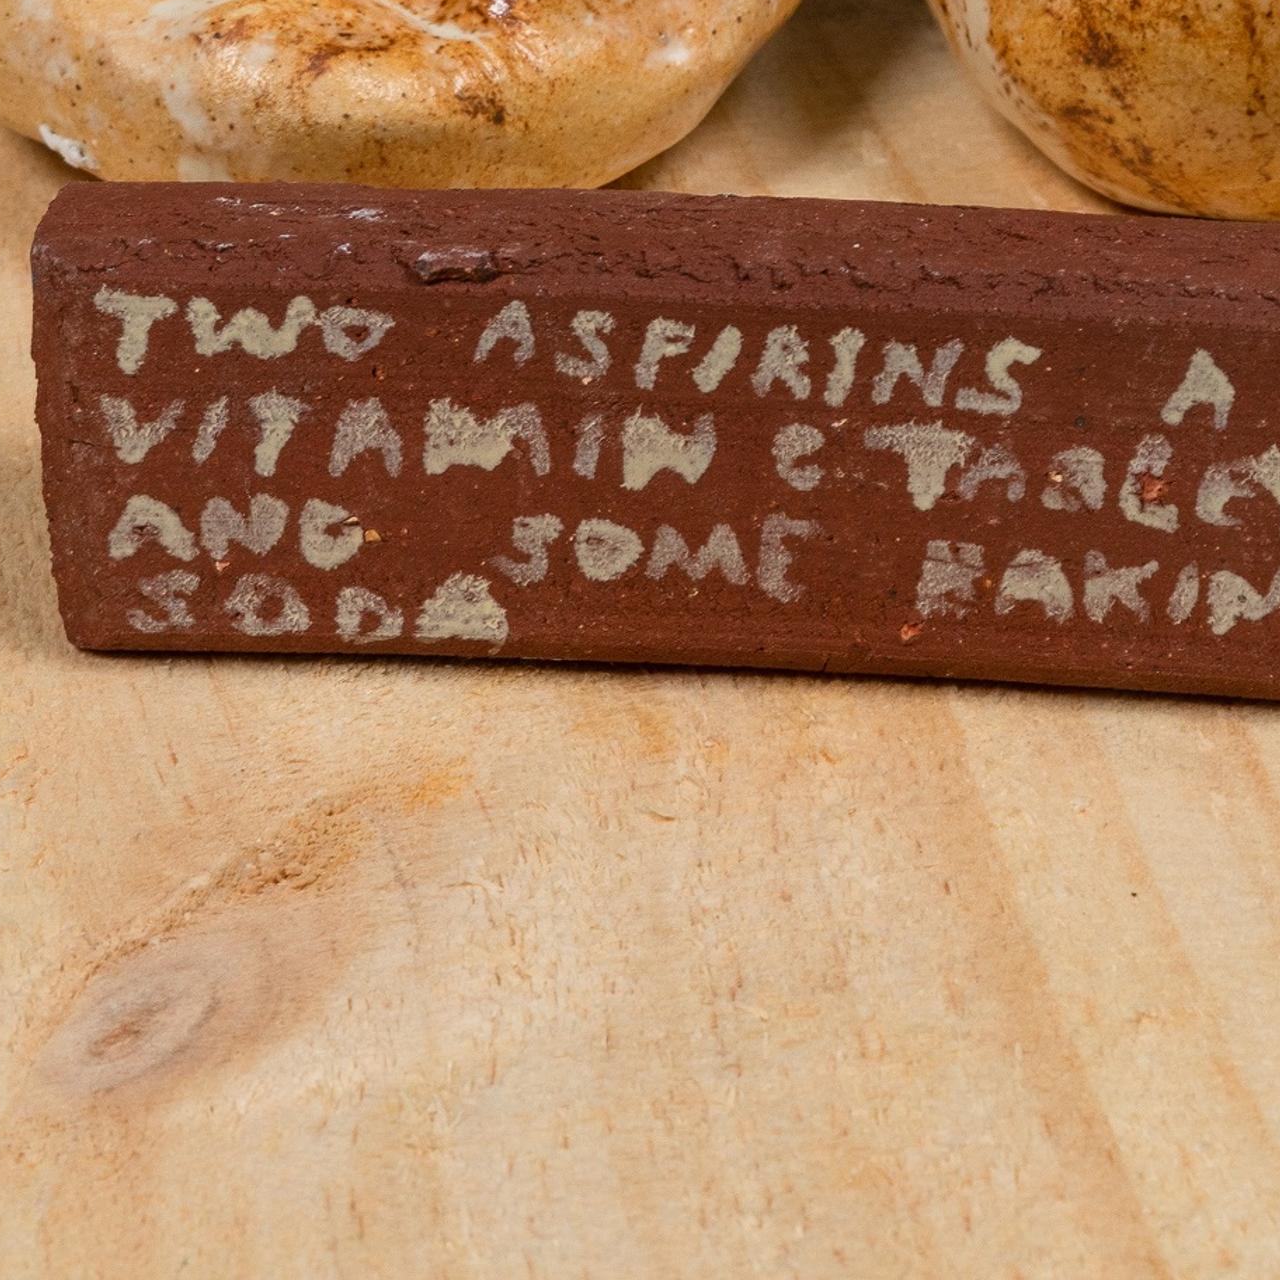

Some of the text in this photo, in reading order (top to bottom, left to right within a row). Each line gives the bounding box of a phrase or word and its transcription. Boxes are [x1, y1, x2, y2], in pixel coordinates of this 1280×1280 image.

[93, 285, 1236, 429] TWO ASPIRINS A
[100, 387, 718, 490] VITAMIN
[108, 494, 365, 570] AND
[490, 513, 821, 603] SOME
[127, 570, 509, 653] SODA
